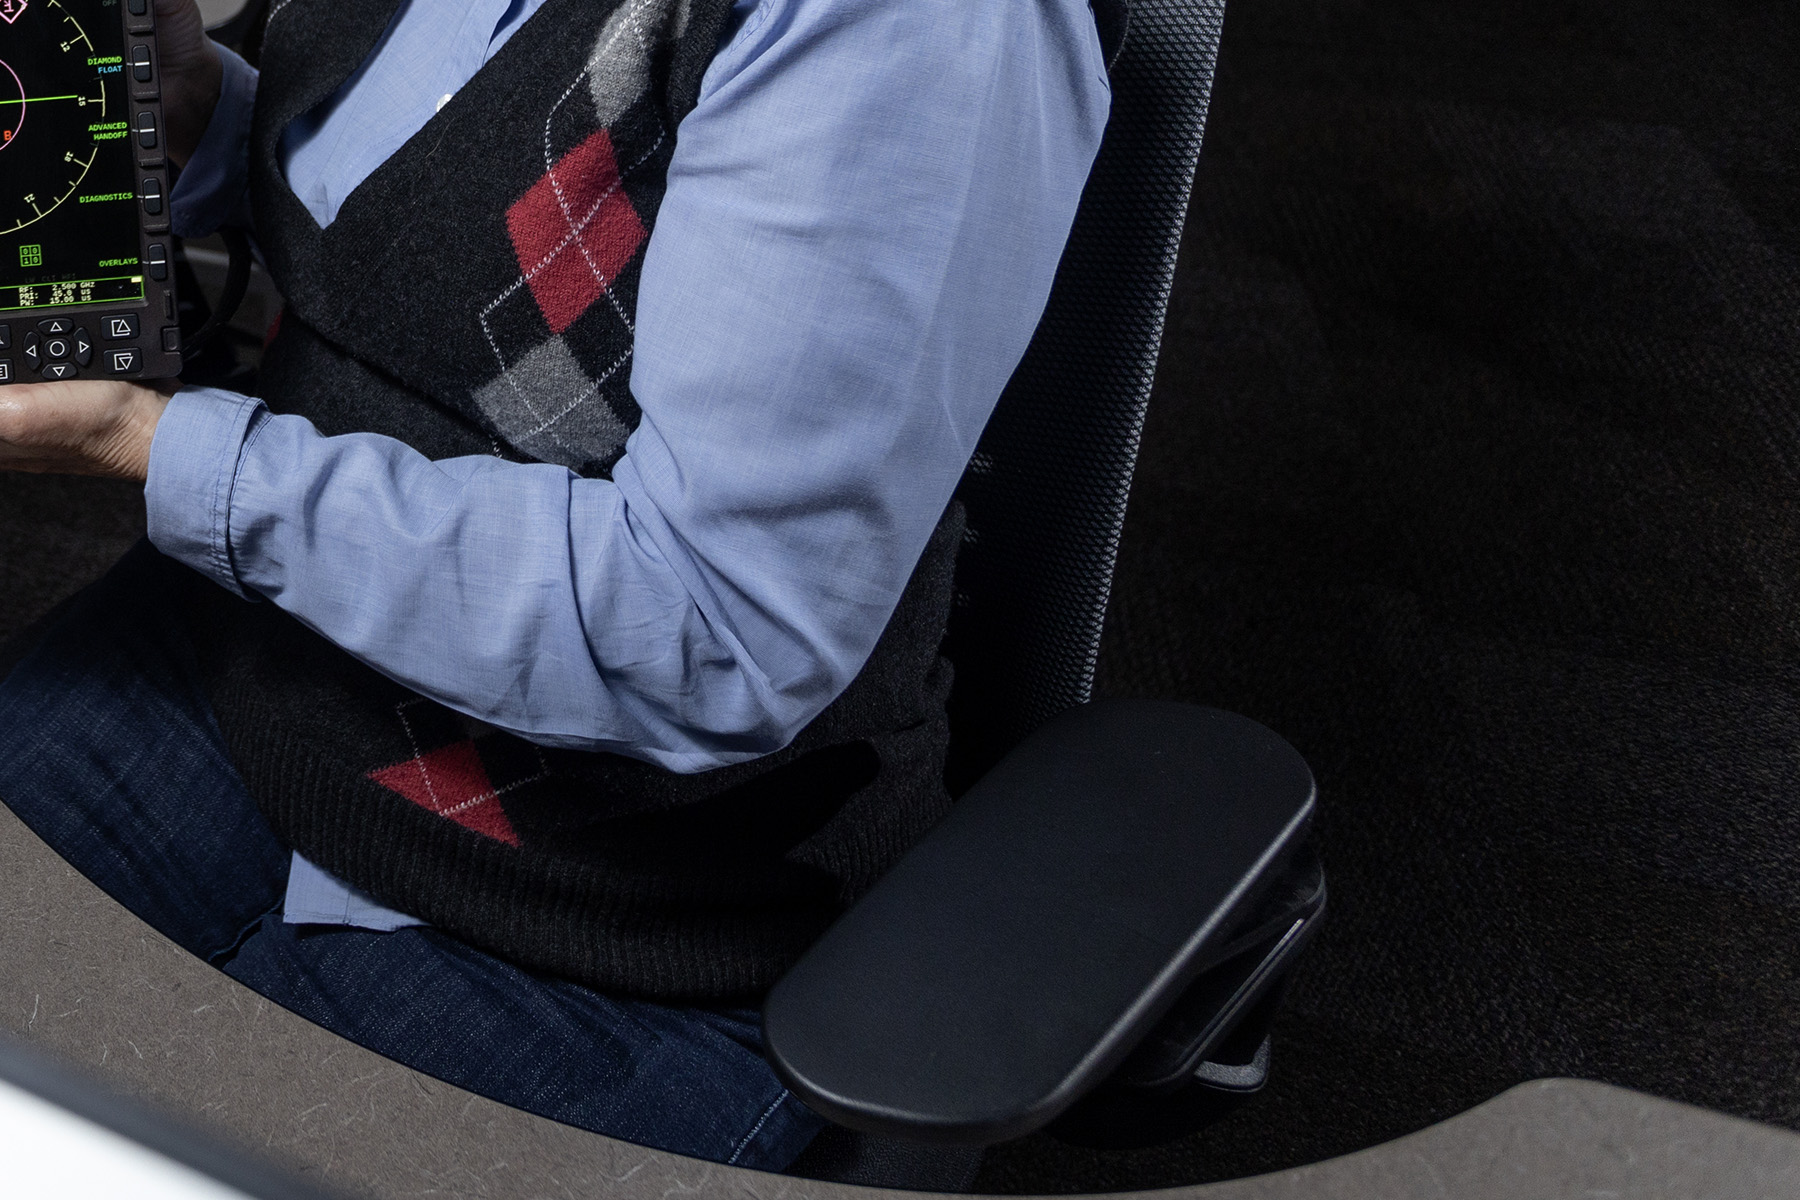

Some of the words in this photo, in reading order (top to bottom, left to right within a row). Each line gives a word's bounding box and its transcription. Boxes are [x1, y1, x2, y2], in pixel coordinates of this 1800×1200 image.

[60, 41, 71, 53] 12
[87, 56, 123, 65] DIAMOND
[98, 65, 123, 74] FLOAT
[78, 96, 86, 107] 15
[88, 122, 128, 132] ADVANCED
[3, 130, 12, 141] B
[93, 131, 128, 140] HANDOFF
[64, 151, 74, 163] 18
[79, 192, 133, 203] DIAGNOSTICS
[99, 258, 138, 267] OVERLAYS
[52, 283, 77, 291] 2.500
[80, 281, 96, 289] GHZ
[19, 292, 39, 300] PRI:
[53, 289, 73, 298] 45.0
[20, 299, 35, 307] PW:
[49, 296, 75, 305] 15.00
